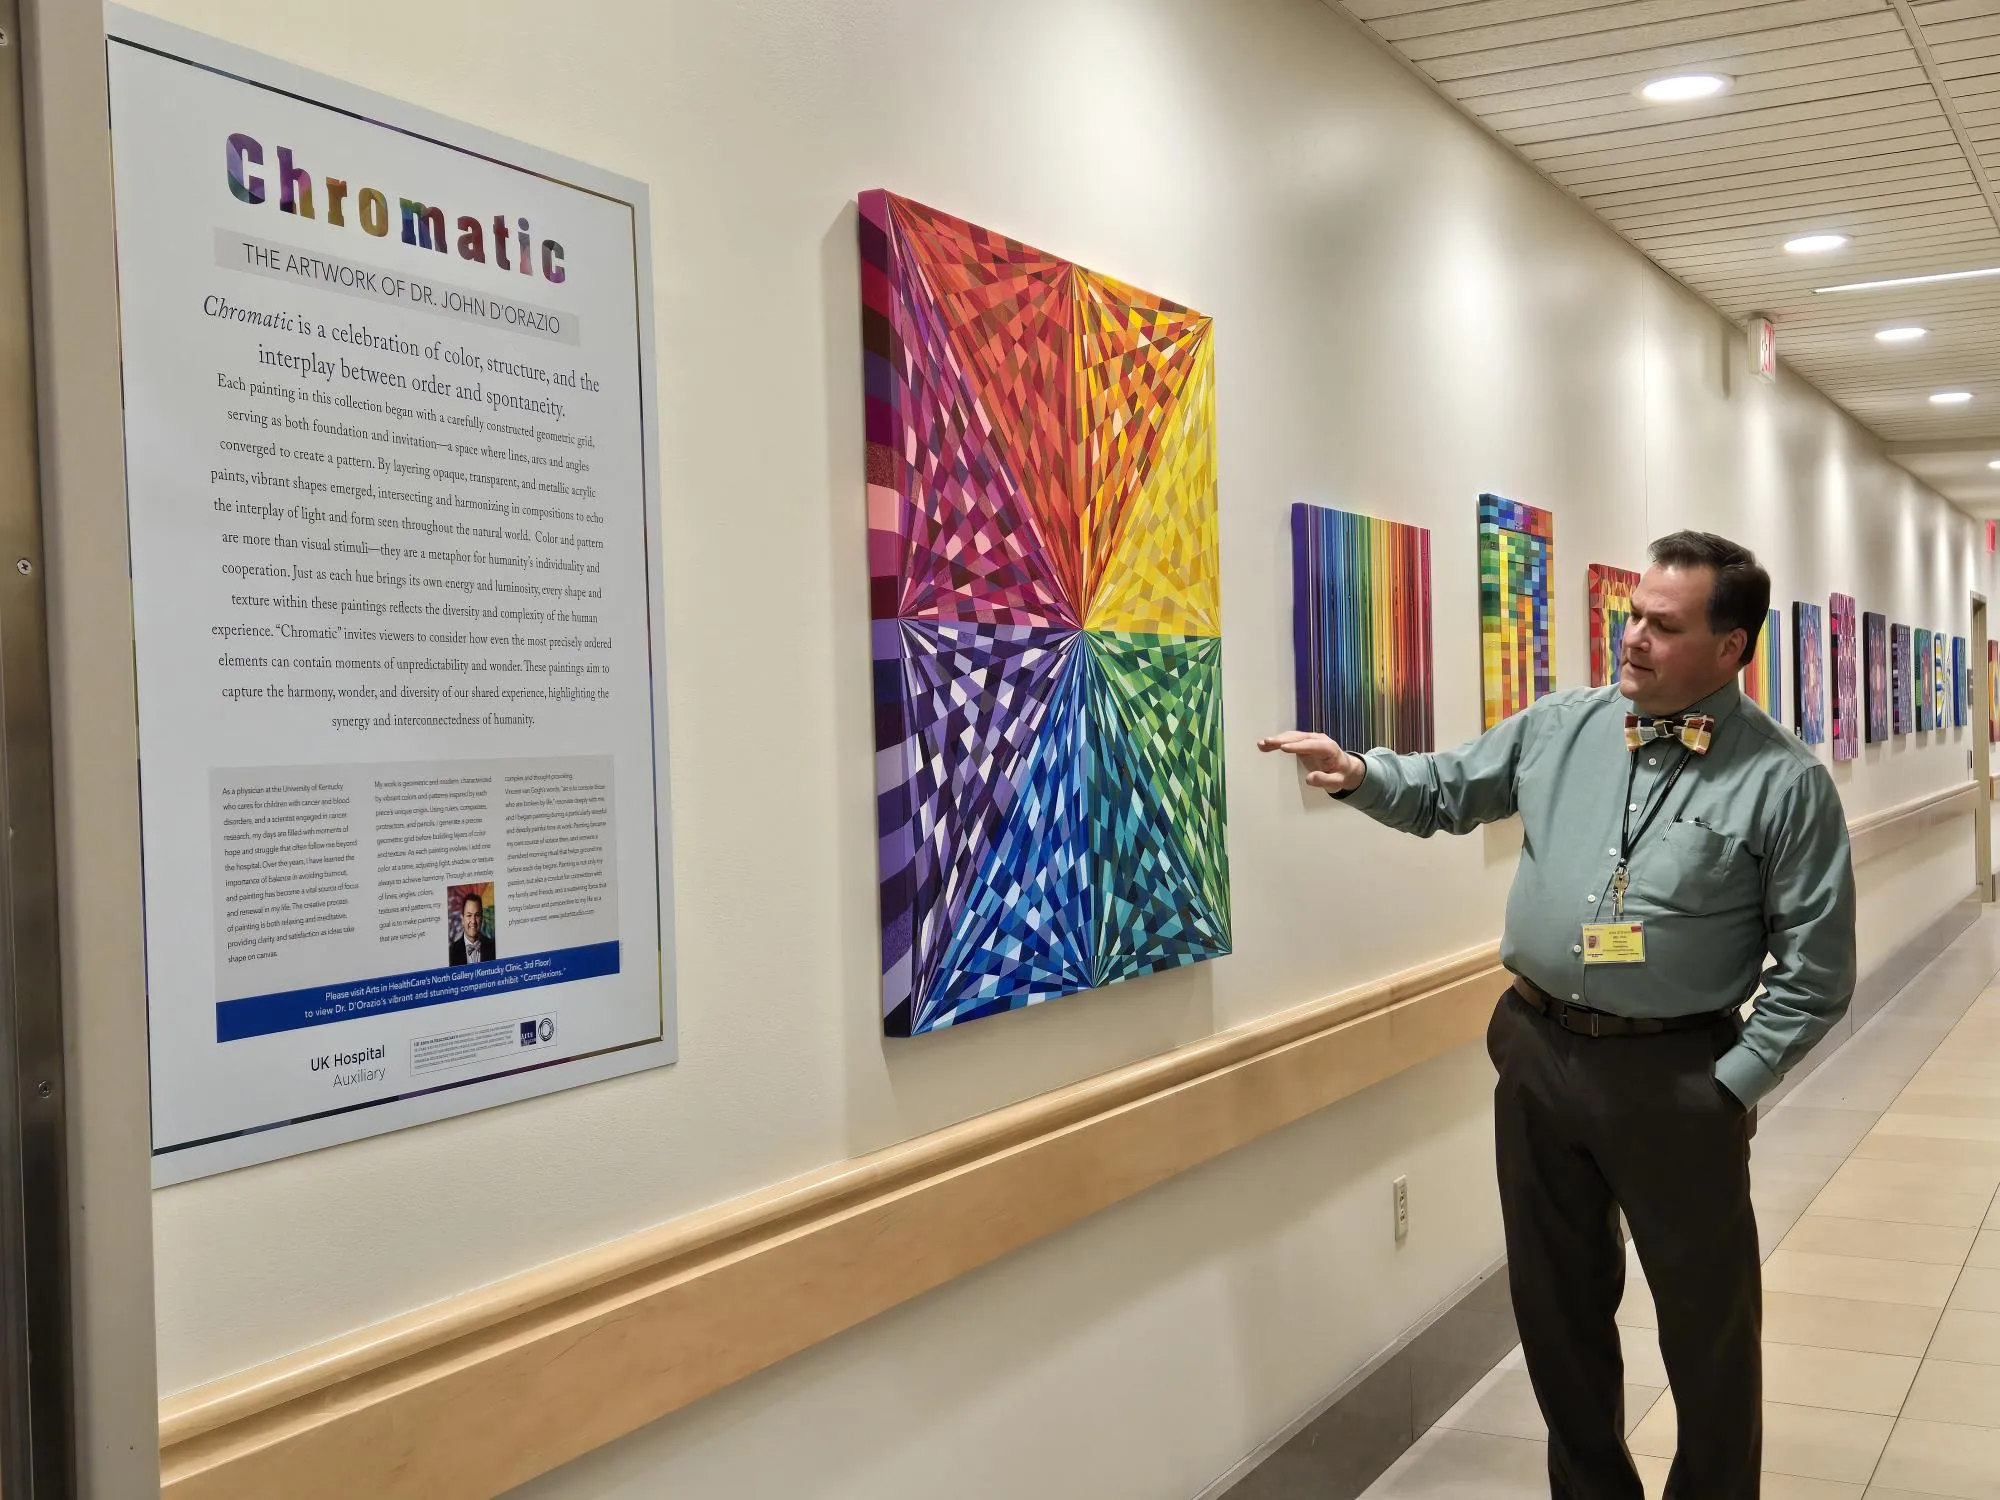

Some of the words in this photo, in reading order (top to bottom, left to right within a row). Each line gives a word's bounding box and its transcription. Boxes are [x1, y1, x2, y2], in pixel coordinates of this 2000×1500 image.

[226, 132, 566, 284] Chromatic
[242, 243, 280, 270] THE
[286, 254, 377, 292] ARTWORK
[381, 276, 405, 298] OF
[410, 282, 437, 306] DR.
[441, 291, 485, 317] JOHN
[203, 295, 294, 332] Chromatic
[297, 314, 312, 336] is
[317, 324, 327, 339] a
[331, 323, 420, 357] celebration
[424, 340, 442, 361] of
[444, 346, 484, 374] color,
[486, 358, 550, 386] structure,
[553, 369, 576, 388] and
[580, 372, 600, 393] the
[258, 343, 336, 382] interplay
[339, 357, 407, 389] between
[412, 374, 451, 397] order
[455, 382, 483, 402] and
[486, 391, 565, 422] spontaneity.
[217, 372, 246, 391] Each
[250, 381, 296, 404] painting
[298, 387, 309, 401] in
[312, 389, 332, 405] this
[334, 394, 383, 413] collection
[385, 401, 414, 421] began
[415, 408, 437, 422] with
[439, 414, 445, 423] a
[446, 414, 484, 433] carefully
[486, 422, 535, 438] constructed
[536, 430, 575, 445] geometric
[577, 435, 595, 449] grid,
[227, 410, 269, 429] serving
[271, 417, 282, 427] as
[284, 414, 310, 431] both
[313, 418, 369, 440] foundation
[371, 429, 389, 442] and
[454, 444, 478, 457] space
[480, 445, 506, 460] where
[508, 448, 530, 465] lines,
[531, 456, 547, 466] arcs
[548, 456, 564, 468] and
[565, 459, 590, 474] angles
[219, 440, 276, 459] converged
[279, 447, 291, 458] to
[293, 450, 325, 462] create
[327, 454, 334, 464] a
[336, 456, 375, 469] pattern.
[377, 456, 391, 475] By
[393, 458, 431, 480] layering
[432, 469, 468, 484] opaque,
[469, 473, 520, 490] transparent,
[521, 477, 536, 490] and
[538, 481, 570, 495] metallic
[571, 485, 596, 500] acrylic
[211, 468, 249, 485] paints,
[250, 471, 290, 488] vibrant
[292, 476, 327, 495] shapes
[330, 484, 376, 500] emerged,
[377, 486, 433, 508] intersecting
[435, 493, 453, 506] and
[454, 494, 510, 517] harmonizing
[511, 502, 520, 514] in
[521, 507, 574, 521] compositions
[576, 512, 585, 522] to
[585, 511, 604, 524] echo
[222, 533, 239, 544] are
[242, 535, 271, 546] more
[274, 533, 298, 548] than
[301, 537, 331, 551] visual
[403, 549, 418, 558] are
[420, 550, 426, 559] a
[428, 549, 472, 565] metaphor
[473, 550, 486, 564] for
[535, 557, 585, 576] individuality
[586, 561, 600, 574] and
[211, 623, 274, 640] experience.
[344, 627, 377, 641] invites
[378, 629, 415, 642] viewers
[417, 632, 427, 642] to
[429, 631, 467, 644] consider
[469, 631, 488, 644] how
[490, 636, 510, 645] even
[511, 633, 525, 646] the
[527, 638, 548, 647] most
[549, 636, 582, 651] precisely
[584, 637, 612, 649] ordered
[221, 687, 263, 702] capture
[266, 683, 284, 698] the
[287, 684, 336, 702] harmony,
[337, 684, 378, 700] wonder,
[379, 684, 398, 698] and
[400, 684, 440, 702] diversity
[442, 685, 453, 697] of
[453, 689, 469, 698] our
[471, 685, 500, 698] shared
[501, 687, 547, 702] experience,
[548, 686, 596, 702] highlighting
[597, 687, 609, 699] the
[332, 718, 370, 731] synergy
[372, 712, 391, 726] and
[394, 712, 480, 726] interconnectedness
[482, 712, 493, 725] of
[493, 712, 535, 728] humanity.
[305, 1010, 313, 1018] to
[315, 1008, 333, 1016] view
[335, 1004, 346, 1013] Dr.
[387, 993, 413, 1004] vibrant
[415, 989, 429, 1000] and
[429, 987, 459, 998] stunning
[460, 980, 496, 992] companion
[497, 975, 519, 986] exhibit
[325, 991, 350, 1001] Please
[350, 988, 365, 997] visit
[365, 986, 380, 995] Arts
[431, 973, 451, 984] North
[451, 970, 474, 981] Gallery
[505, 963, 523, 972] Clinic,
[524, 960, 534, 969] 3rd
[534, 958, 551, 967] Floor)
[311, 1055, 330, 1072] UK
[334, 1044, 385, 1068] Hospital
[332, 1067, 386, 1088] Auxiliary
